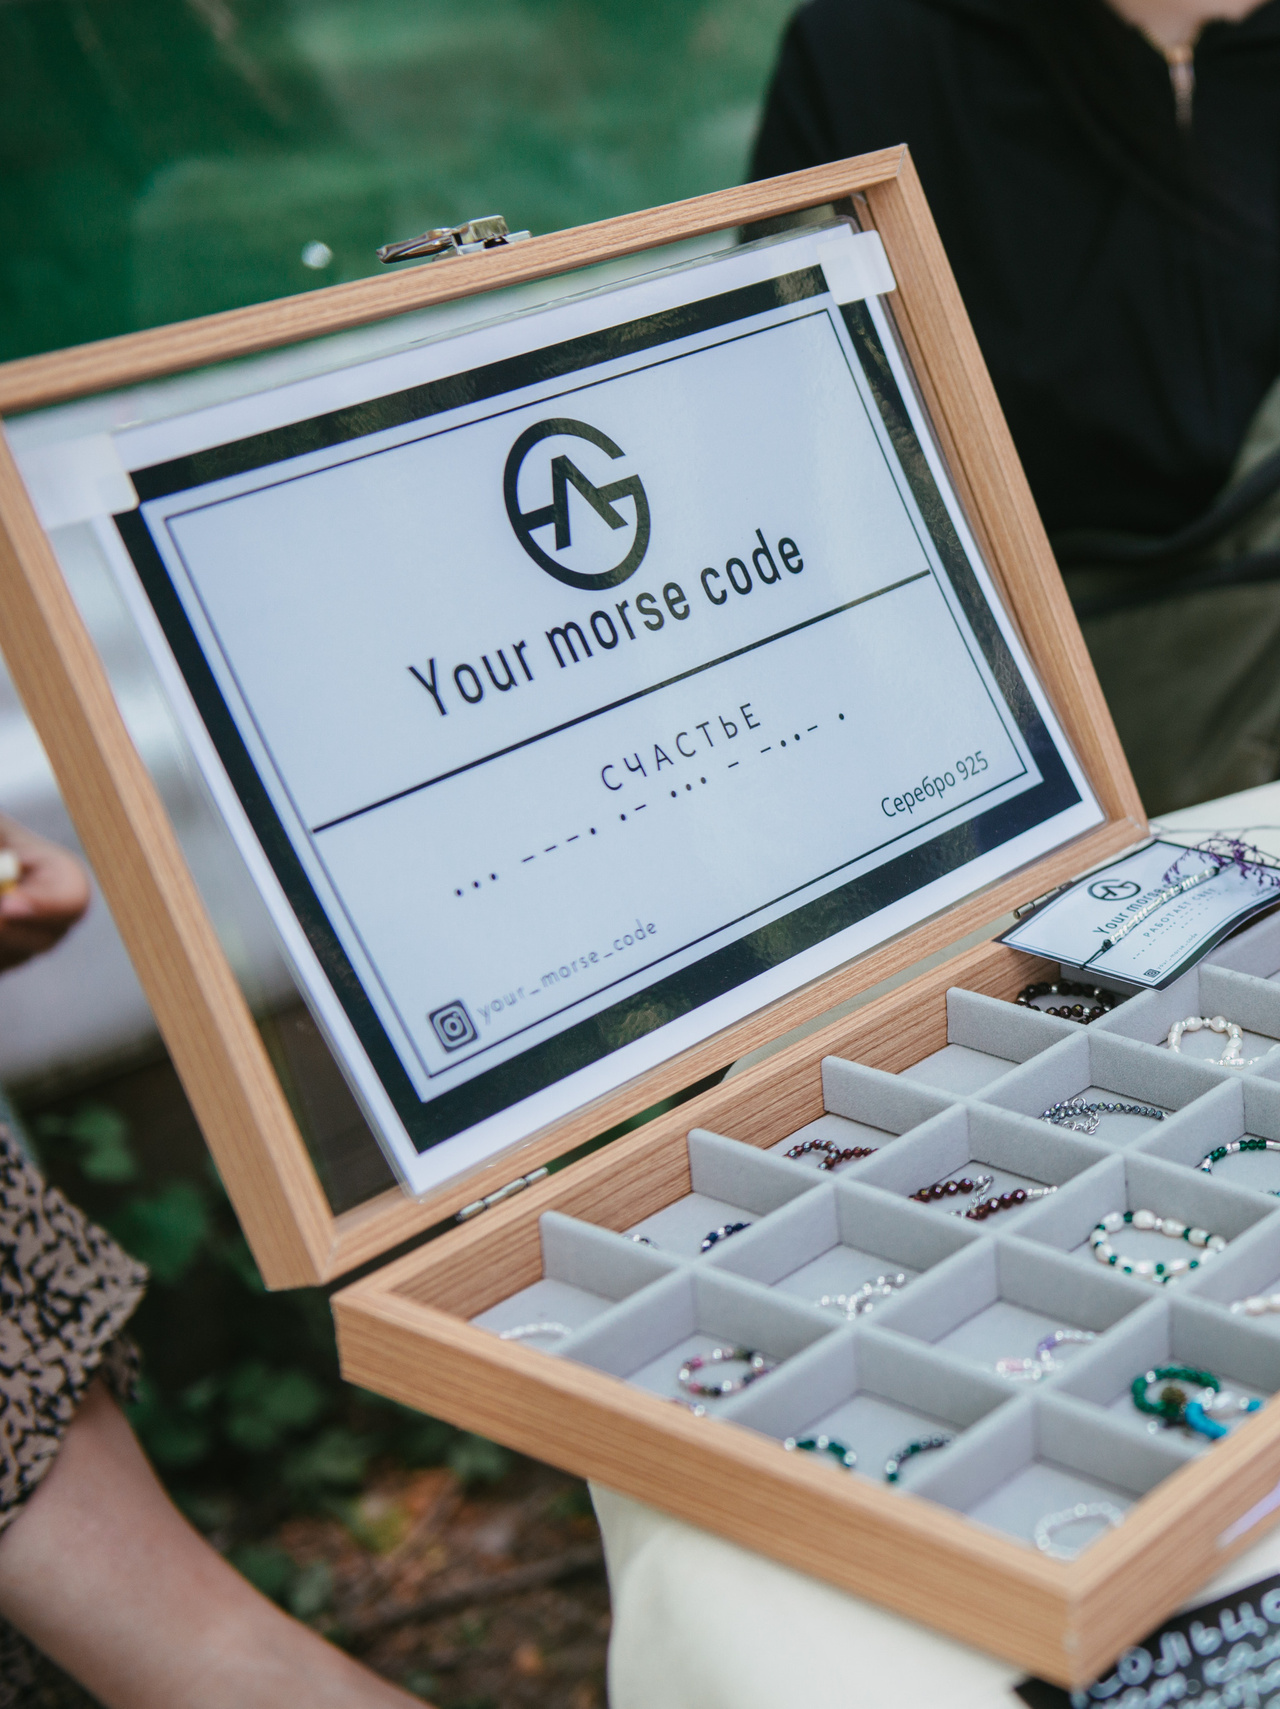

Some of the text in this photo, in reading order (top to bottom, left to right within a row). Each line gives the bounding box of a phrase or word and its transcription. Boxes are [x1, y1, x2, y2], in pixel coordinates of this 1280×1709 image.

[408, 528, 804, 716] Your morse code
[600, 702, 761, 792] СЧАСТЬЕ
[880, 750, 990, 819] Серебро 925
[1092, 912, 1129, 935] Your
[476, 918, 658, 1024] your_morse_code
